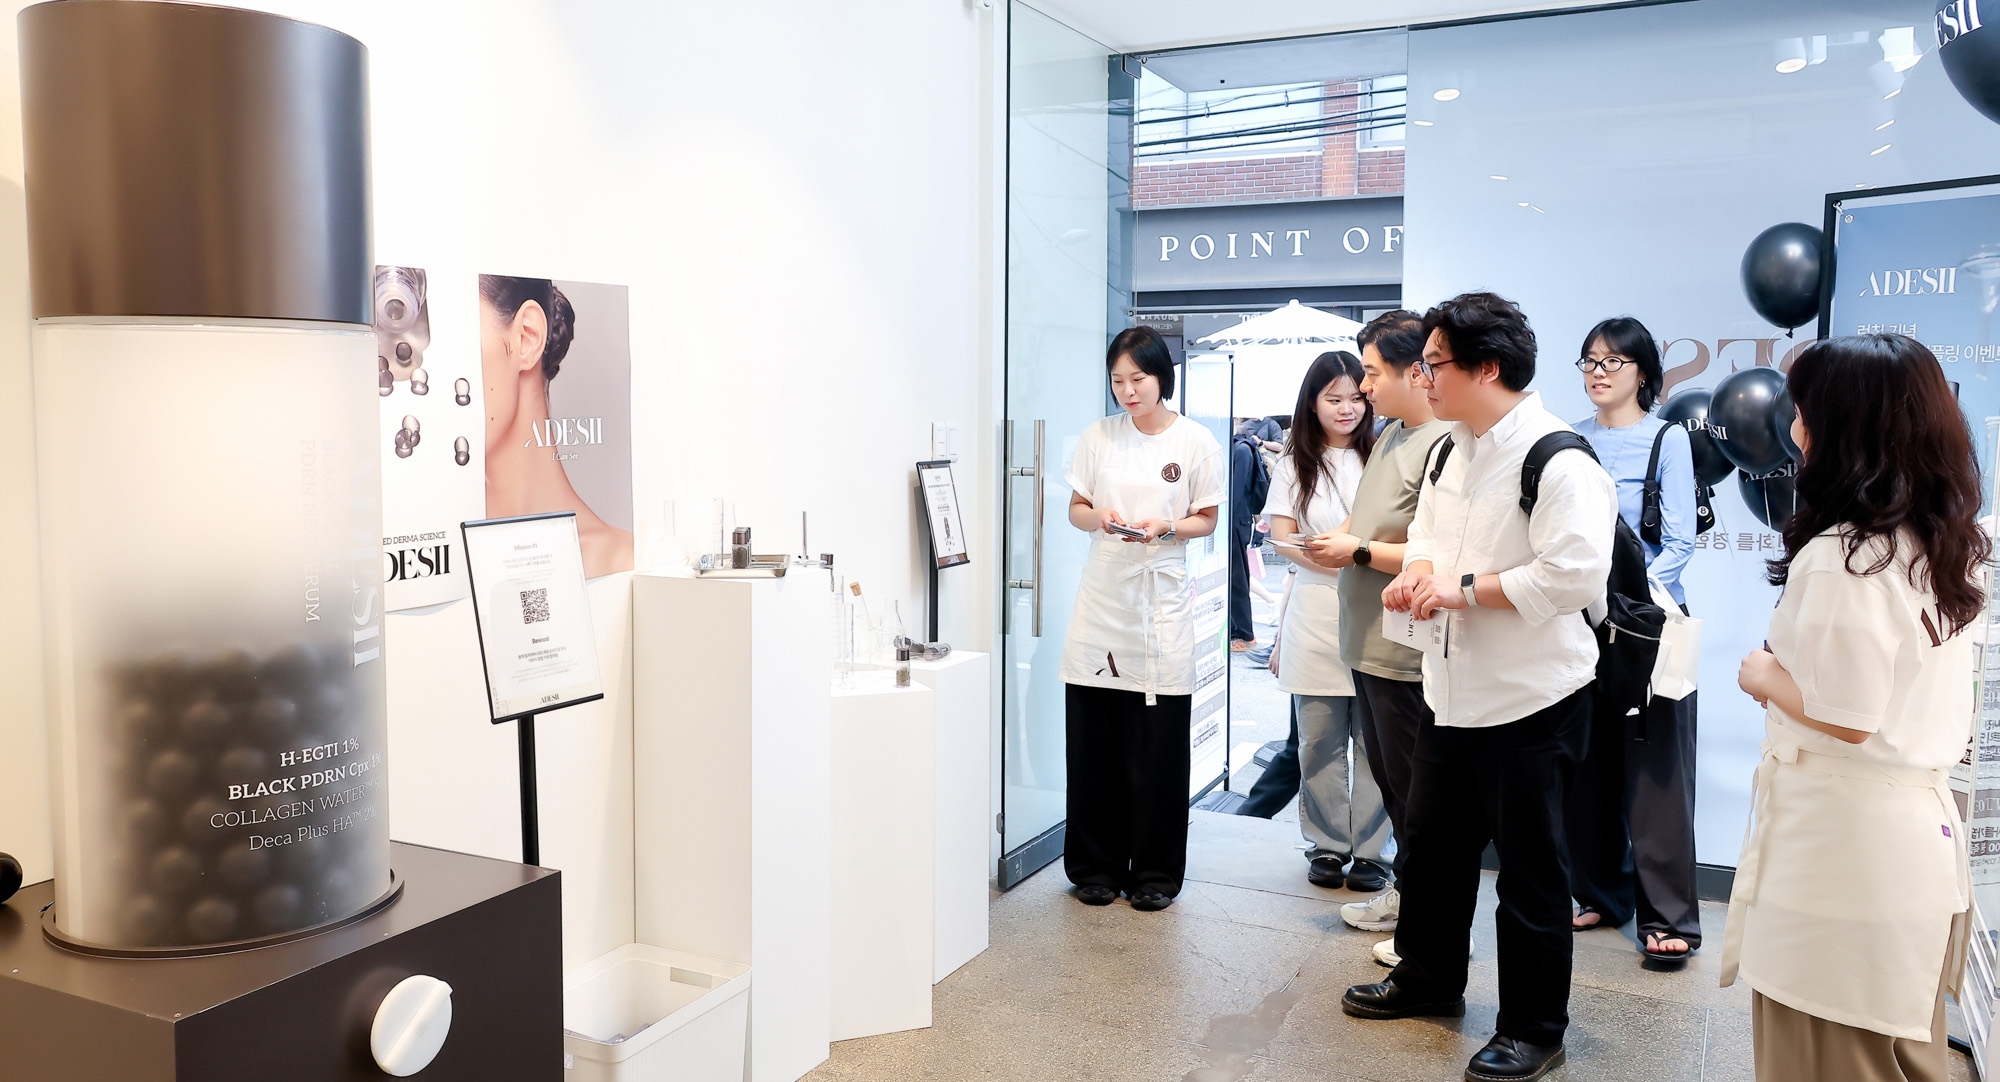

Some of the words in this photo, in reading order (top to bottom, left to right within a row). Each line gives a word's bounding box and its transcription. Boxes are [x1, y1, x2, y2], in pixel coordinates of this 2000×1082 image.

[1935, 0, 1983, 49] ESII
[1159, 229, 1310, 261] POINT
[1342, 225, 1404, 254] OF
[1859, 267, 1958, 297] ADESII
[1926, 344, 1960, 363] 플링
[524, 417, 603, 448] ADESII
[383, 537, 392, 545] ED
[393, 534, 418, 544] DERMA
[419, 531, 446, 541] SCIENCE
[383, 544, 450, 582] DESII
[280, 742, 339, 767] H-EGTI
[342, 736, 360, 754] 1%
[228, 777, 296, 800] BLACK
[300, 765, 346, 790] PDRN
[349, 760, 370, 777] Cpx
[371, 751, 382, 769] 1%
[210, 799, 315, 828] COLLAGEN
[249, 833, 293, 850] Deca
[298, 824, 329, 842] Plus
[364, 804, 377, 822] 2%
